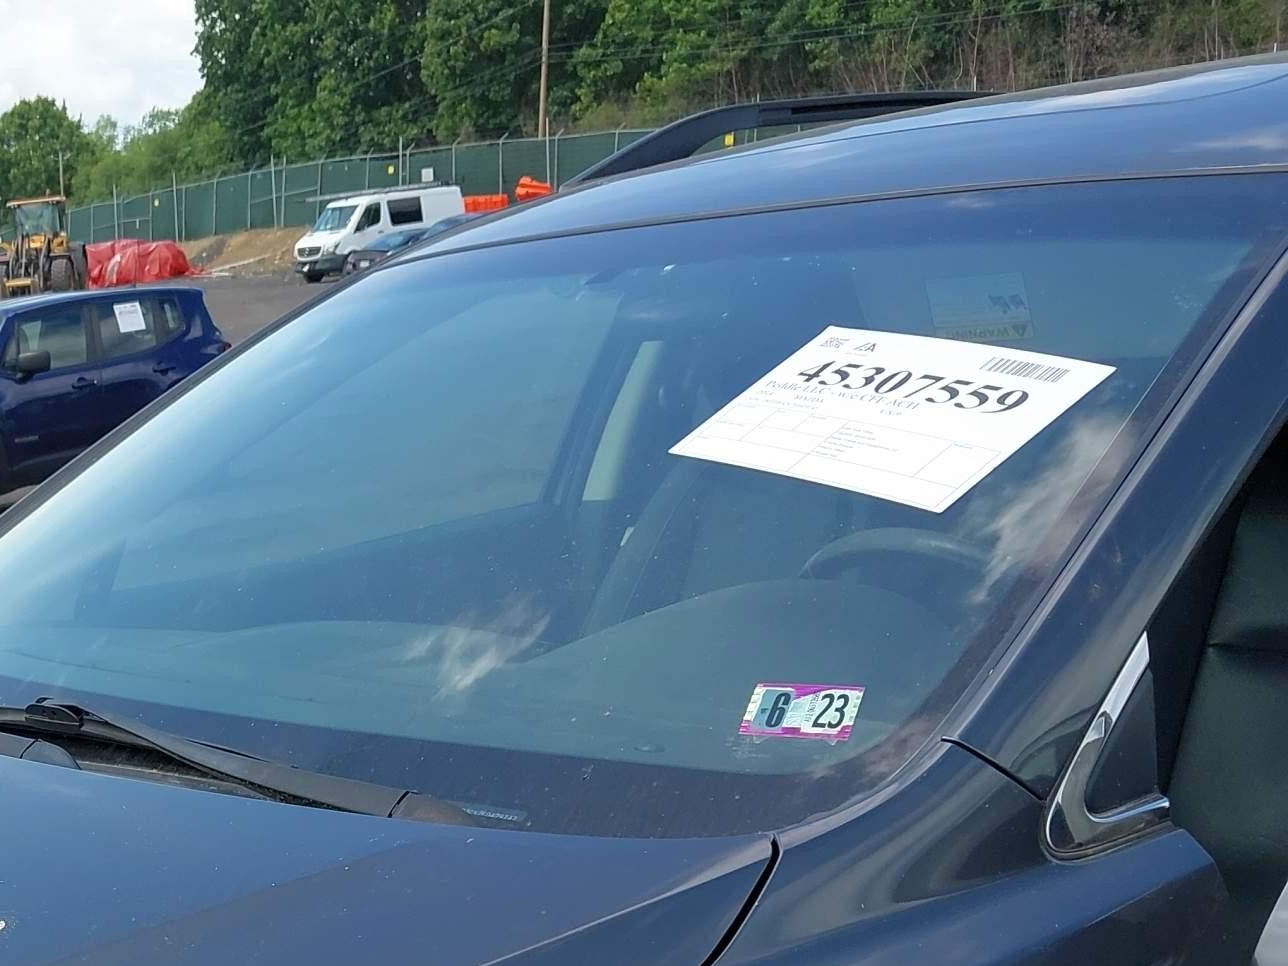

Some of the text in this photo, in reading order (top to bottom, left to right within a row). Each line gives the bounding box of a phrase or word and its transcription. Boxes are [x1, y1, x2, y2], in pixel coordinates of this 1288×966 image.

[797, 360, 1030, 414] 45307559
[765, 692, 791, 728] 6
[812, 693, 850, 729] 23
